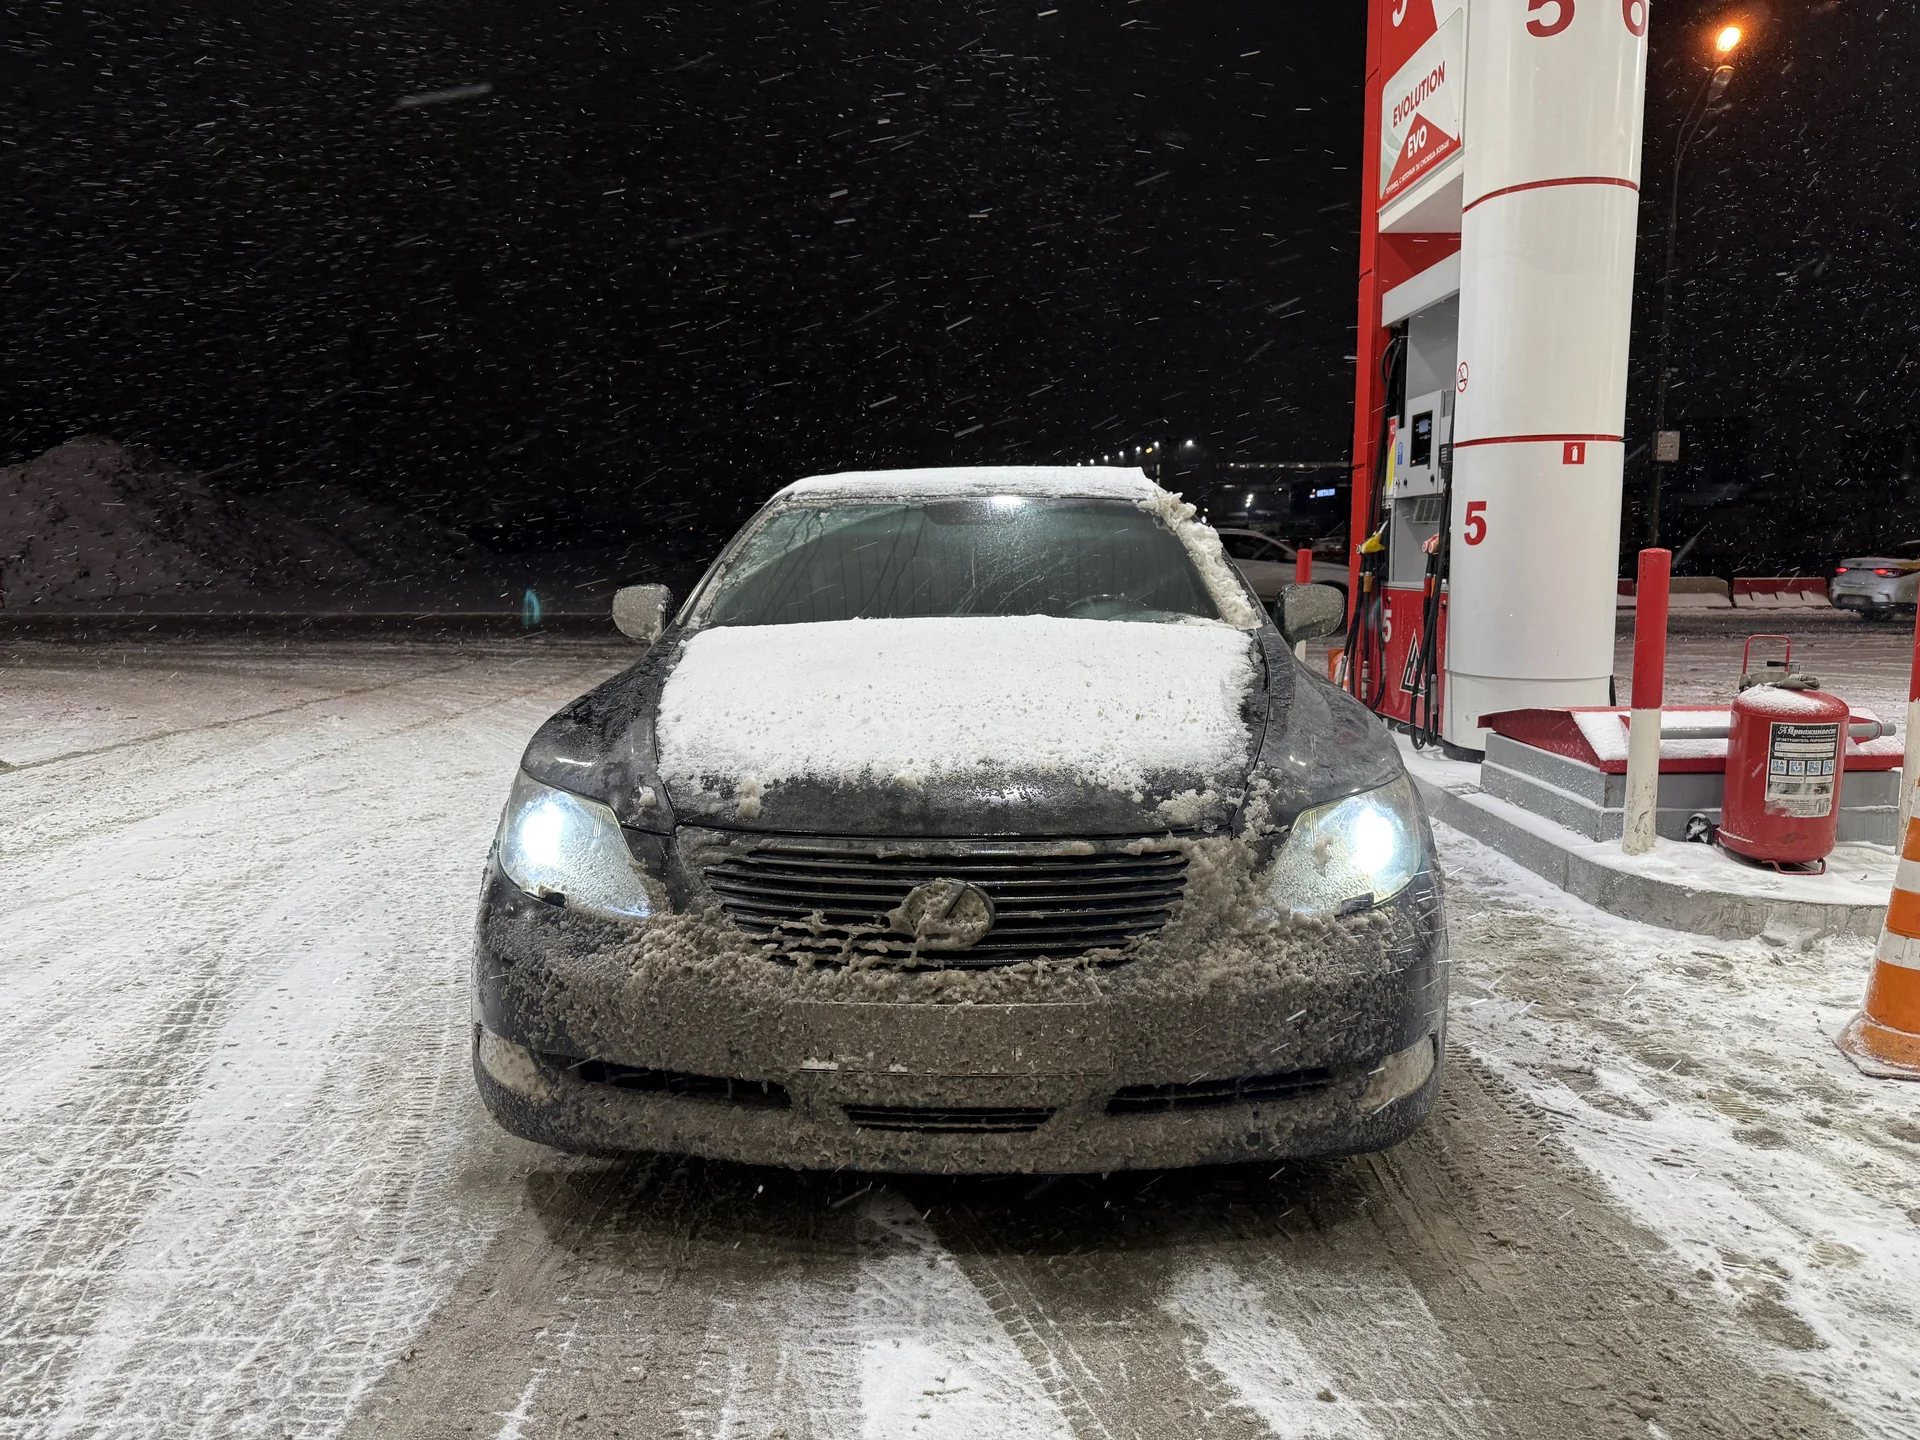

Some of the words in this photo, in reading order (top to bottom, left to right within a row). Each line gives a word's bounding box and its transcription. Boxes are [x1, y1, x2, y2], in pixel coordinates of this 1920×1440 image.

[1526, 0, 1575, 37] 5
[1393, 60, 1446, 128] EVOLUTION
[1407, 125, 1428, 159] EVO
[1463, 500, 1487, 546] 5
[1382, 609, 1392, 643] 5
